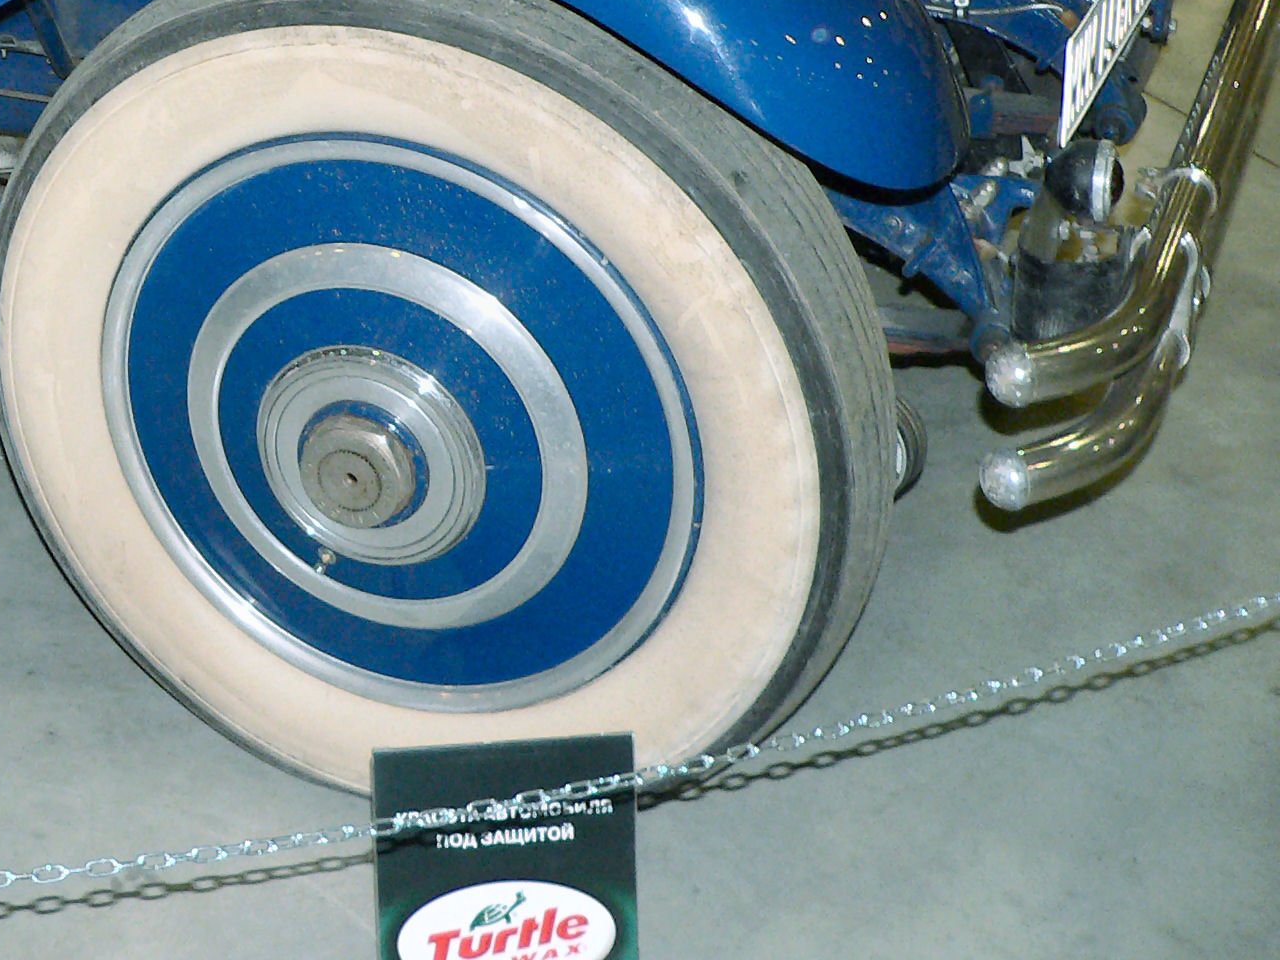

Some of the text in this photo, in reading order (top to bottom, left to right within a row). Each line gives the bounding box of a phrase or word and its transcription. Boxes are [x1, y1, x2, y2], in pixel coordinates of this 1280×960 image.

[436, 822, 575, 849] ПОД ЗАЩИТОЙ
[427, 907, 590, 960] Turtle
